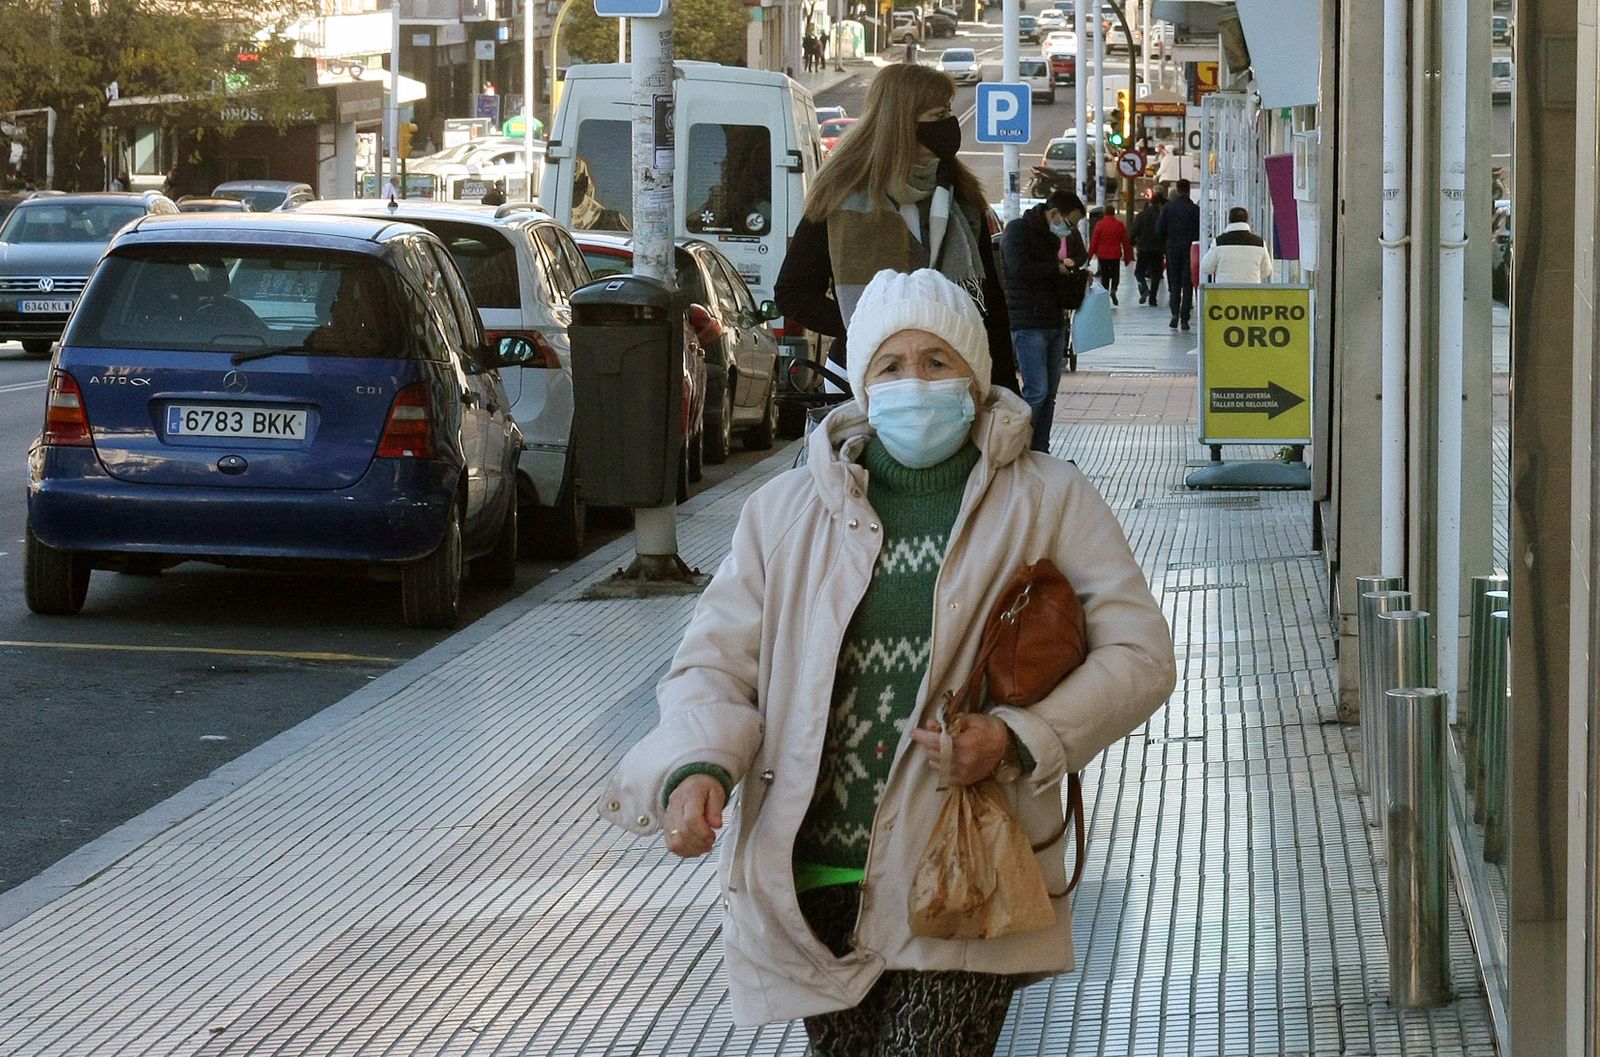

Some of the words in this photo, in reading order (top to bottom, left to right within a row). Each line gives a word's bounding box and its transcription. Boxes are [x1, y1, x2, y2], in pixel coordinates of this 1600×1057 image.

[988, 91, 1018, 136] P
[25, 302, 48, 311] 6340
[1208, 305, 1305, 321] COMPRO
[1223, 326, 1290, 348] ORO
[90, 376, 127, 385] A170
[356, 386, 383, 394] CDI
[186, 410, 244, 433] 6783
[252, 412, 297, 435] BKK
